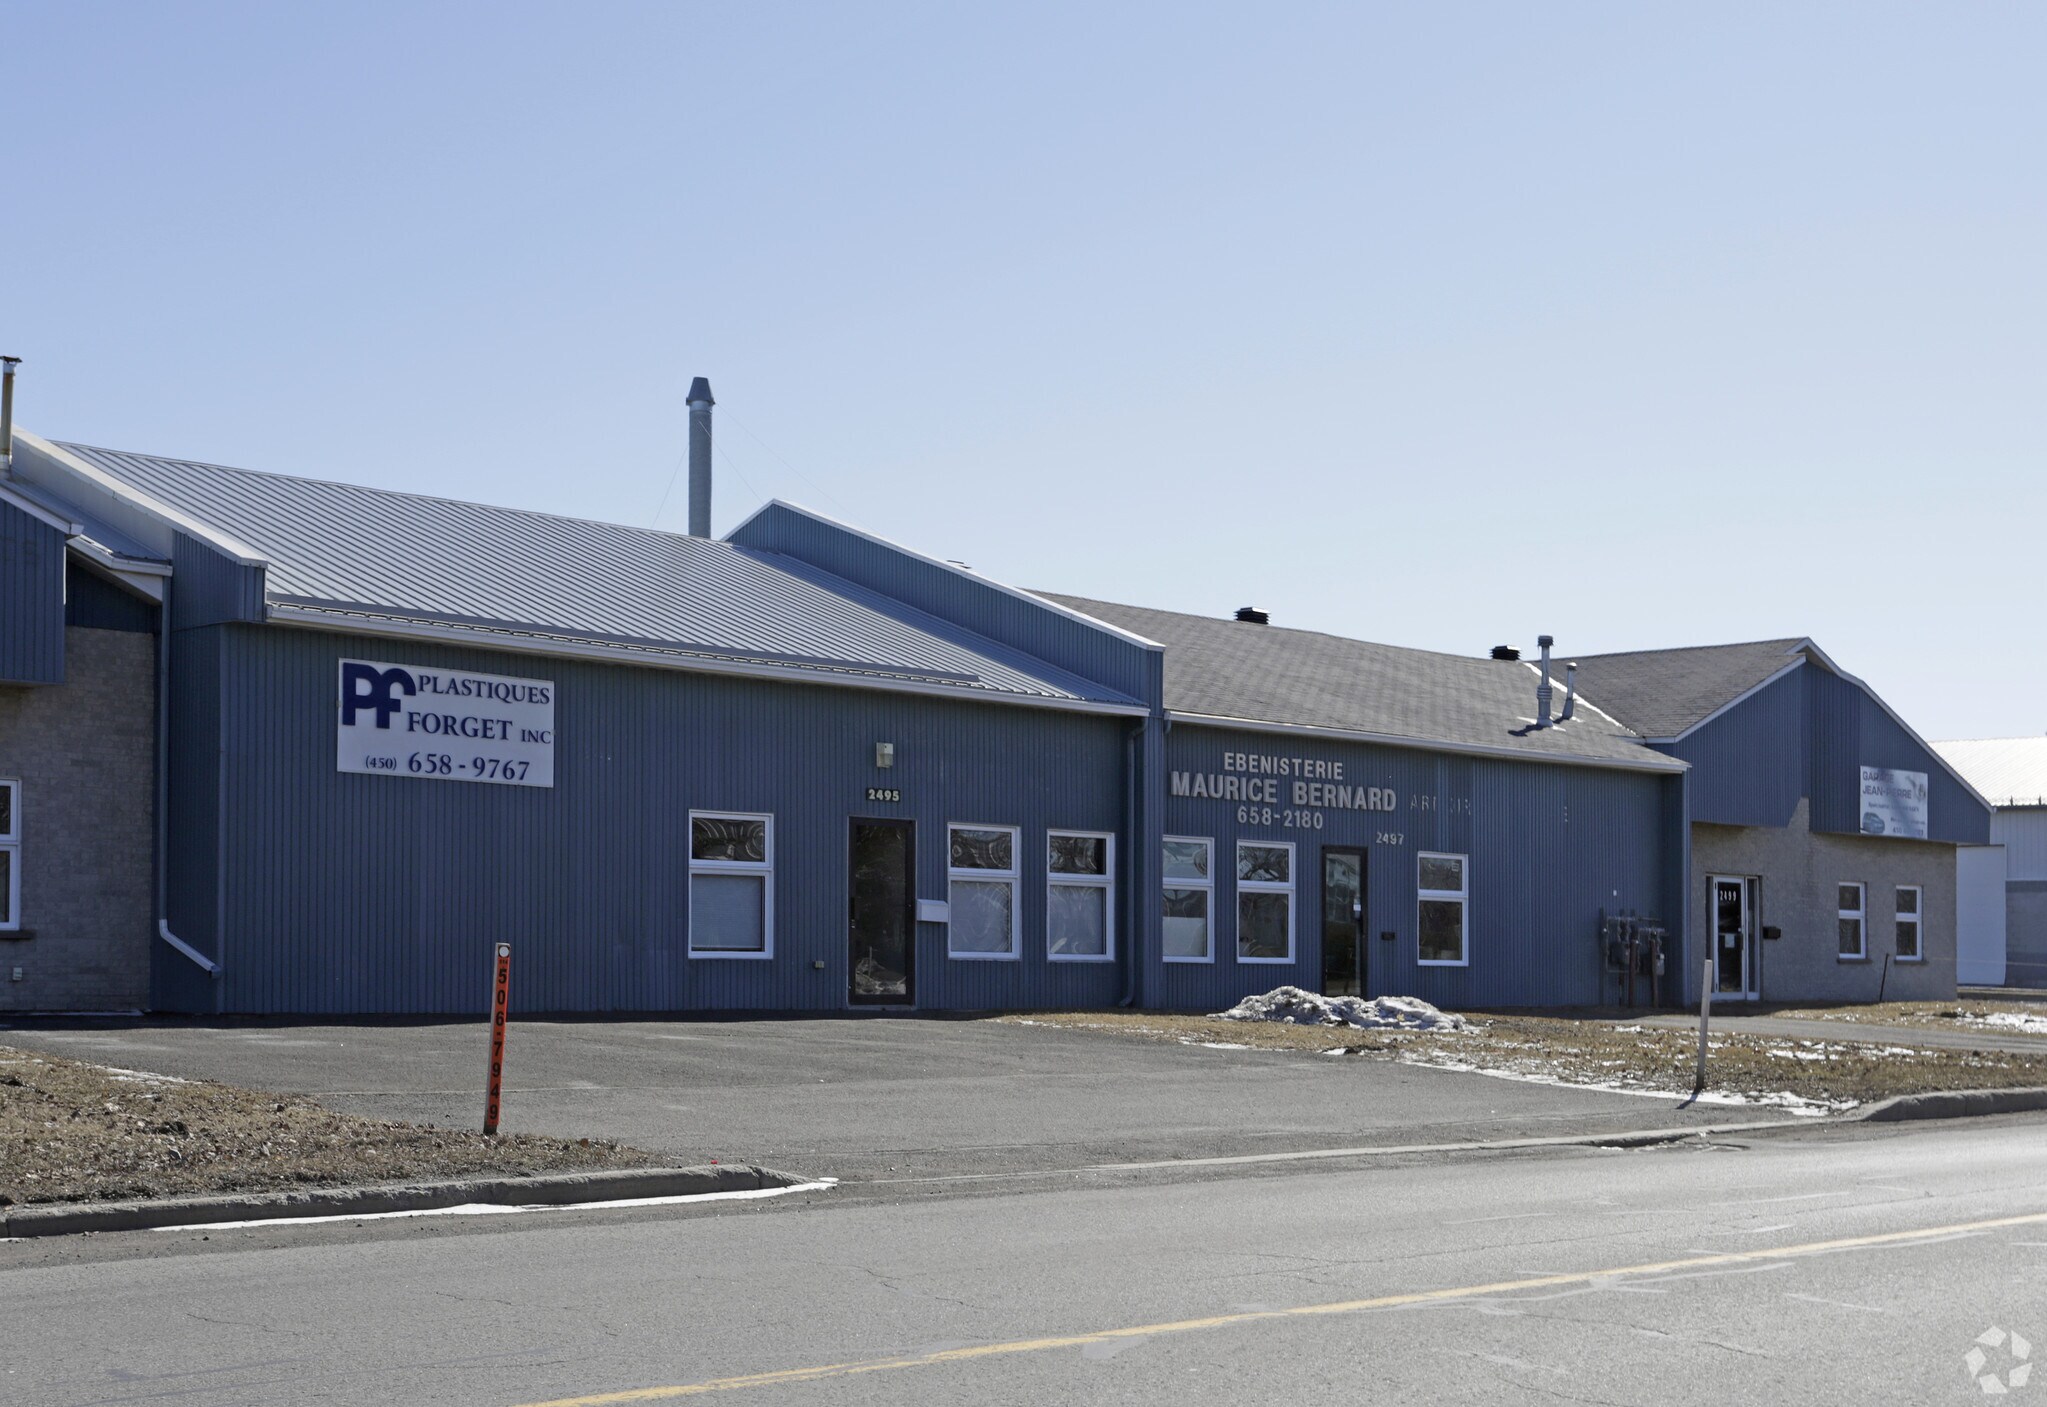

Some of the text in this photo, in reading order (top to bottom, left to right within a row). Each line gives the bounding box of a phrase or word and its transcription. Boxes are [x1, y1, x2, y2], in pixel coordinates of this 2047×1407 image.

[418, 674, 550, 705] PLASTIQUES
[407, 711, 551, 744] FORGET INC
[365, 755, 397, 771] (450)
[1224, 751, 1344, 781] EBENISTERIE
[868, 788, 900, 802] 2495
[1170, 770, 1278, 804] MAURICE
[1292, 780, 1397, 812] BERNARD
[1862, 784, 1912, 800] JEAN-PERRE
[1237, 805, 1323, 830] 658-2180
[1375, 831, 1405, 846] 2497
[1719, 890, 1737, 901] 2499
